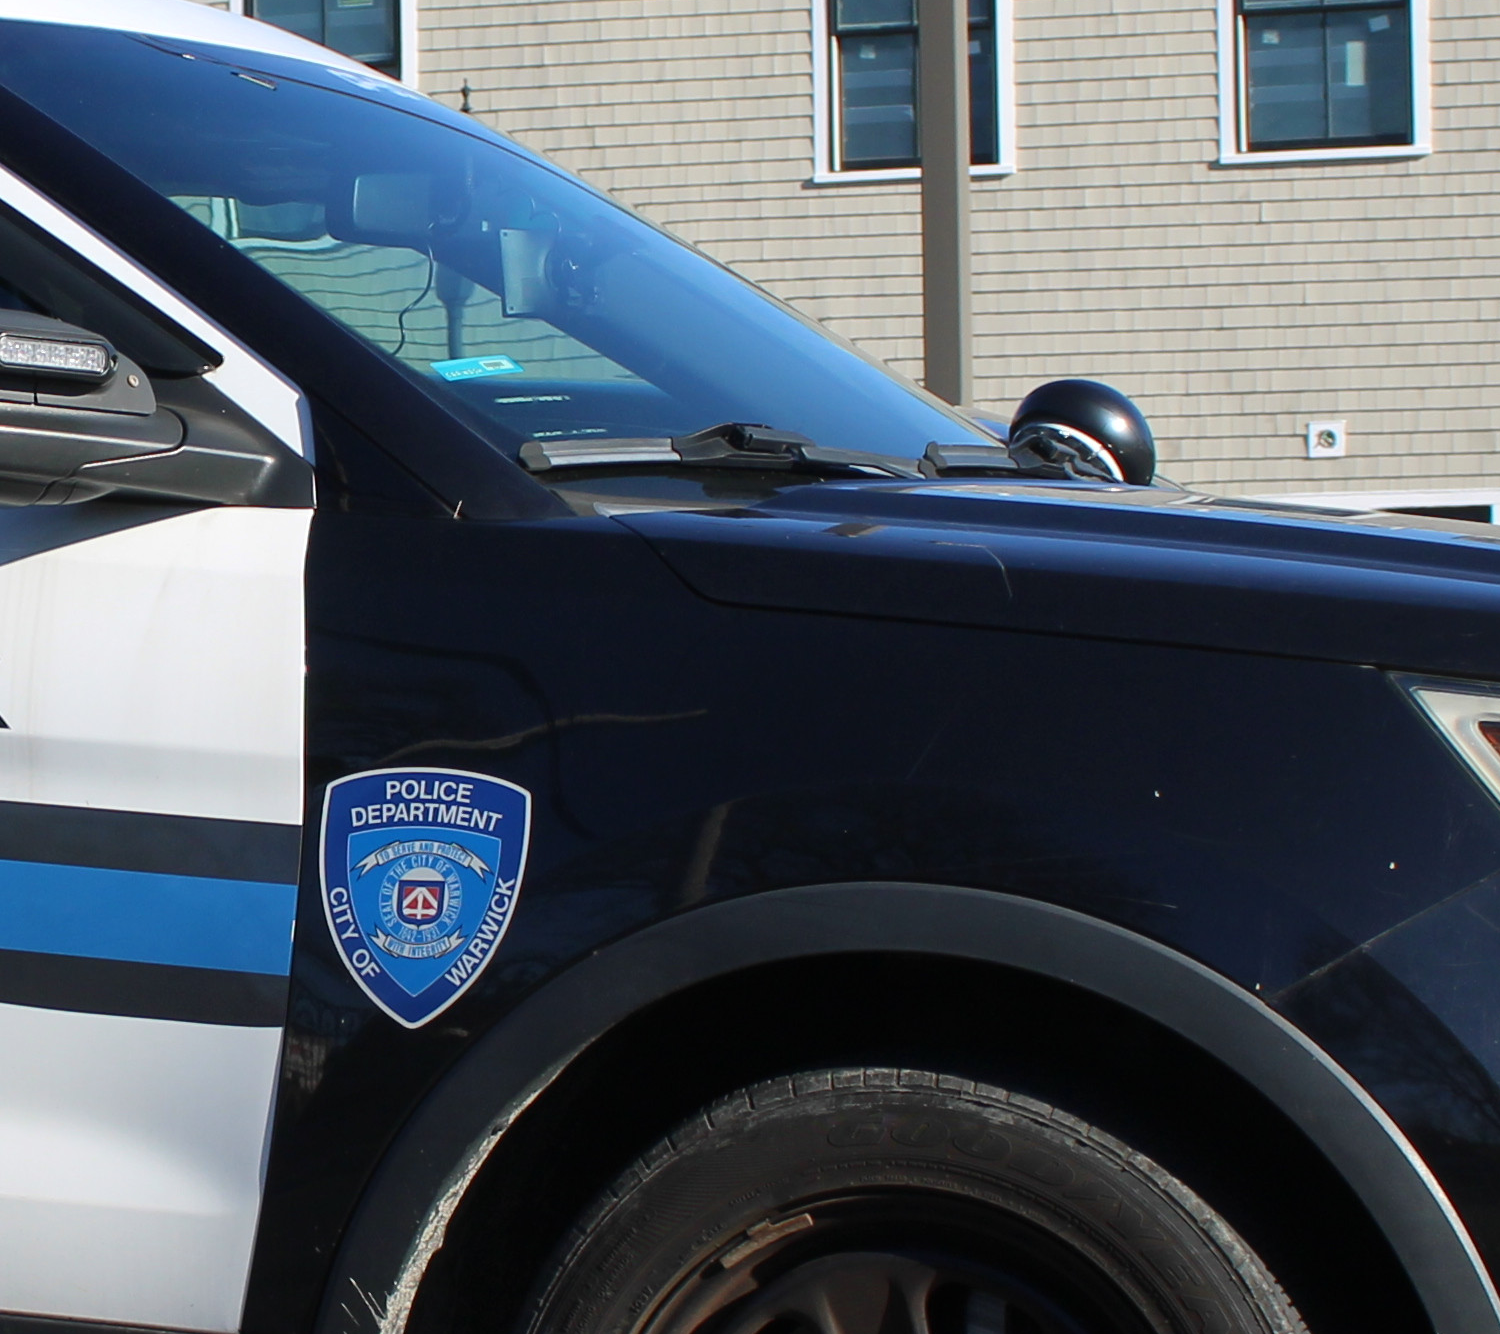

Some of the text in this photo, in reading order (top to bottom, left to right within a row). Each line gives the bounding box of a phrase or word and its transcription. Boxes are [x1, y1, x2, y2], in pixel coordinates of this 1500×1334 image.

[386, 779, 474, 804] POLICE
[351, 803, 503, 832] DEPARTMENT
[382, 855, 462, 928] SEAL OF THE CITY OF WARWICK
[330, 877, 516, 987] CITY OF WARWICK
